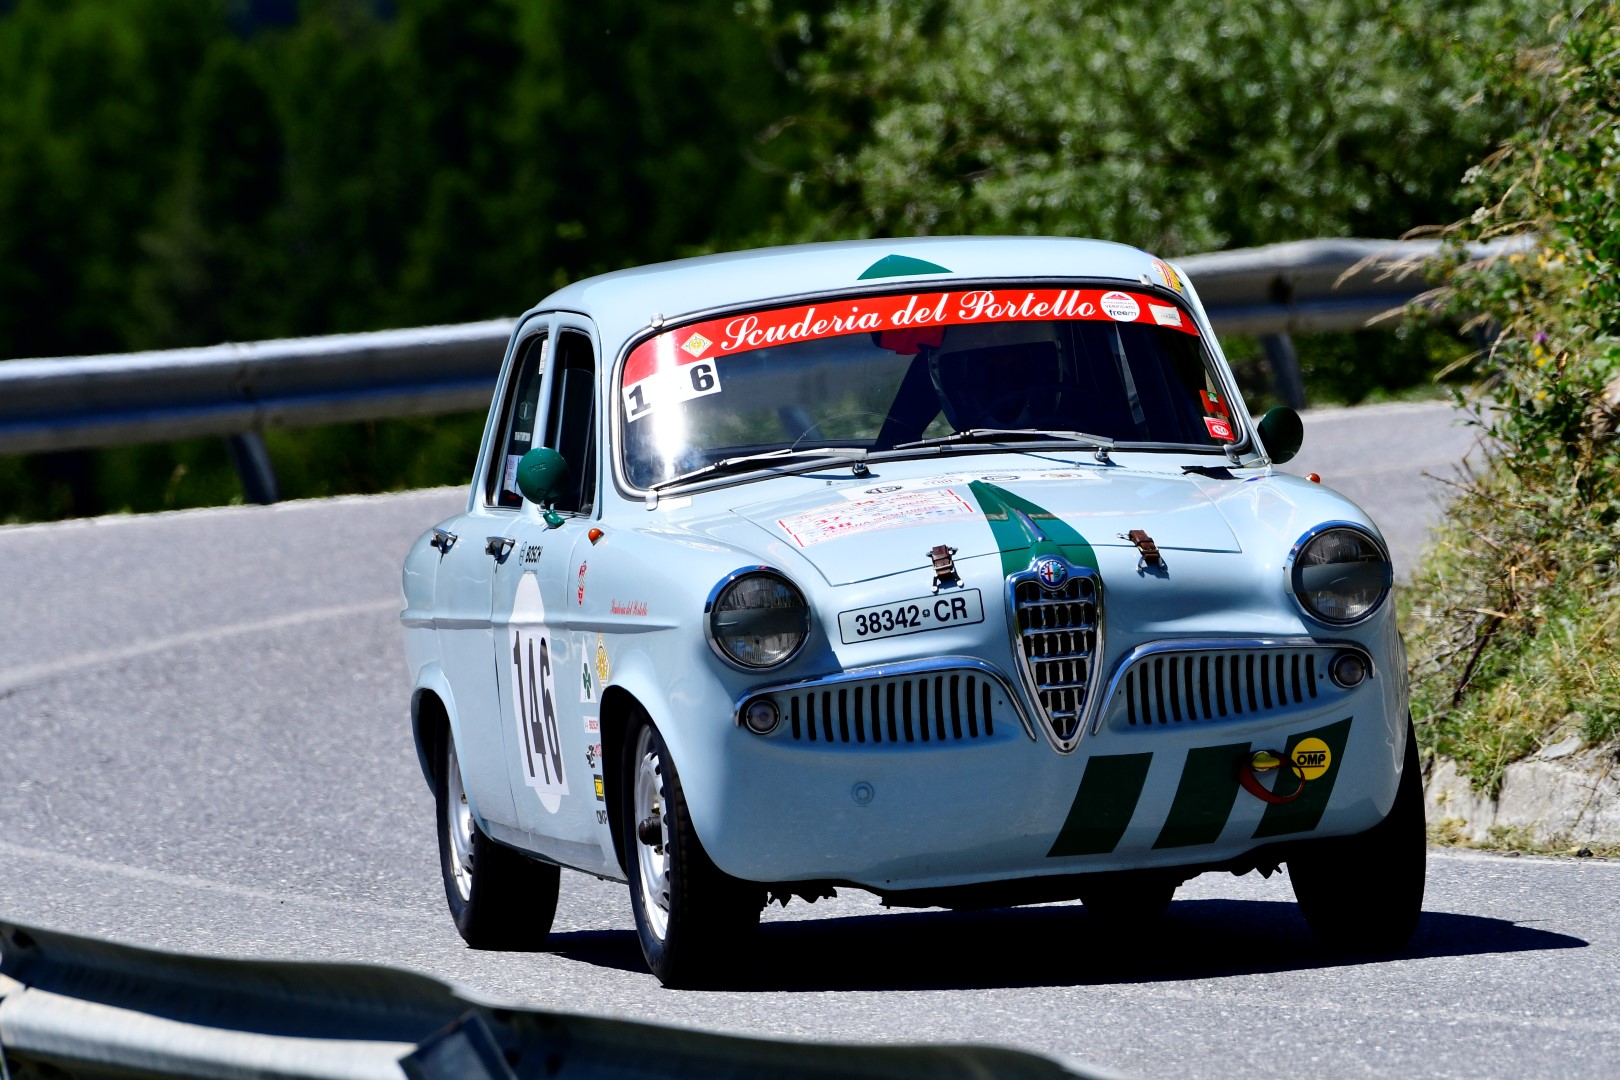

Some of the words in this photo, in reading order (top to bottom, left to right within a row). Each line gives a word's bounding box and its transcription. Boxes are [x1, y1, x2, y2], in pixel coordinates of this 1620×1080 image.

[721, 306, 880, 351] Scuderia
[891, 293, 947, 326] del
[960, 290, 1096, 320] Portello
[1108, 308, 1137, 317] freem
[628, 364, 715, 417] 16
[525, 545, 543, 563] BOSCH
[855, 604, 922, 637] 38342
[933, 597, 968, 623] CR
[513, 630, 564, 786] 146
[1296, 754, 1326, 766] OMP
